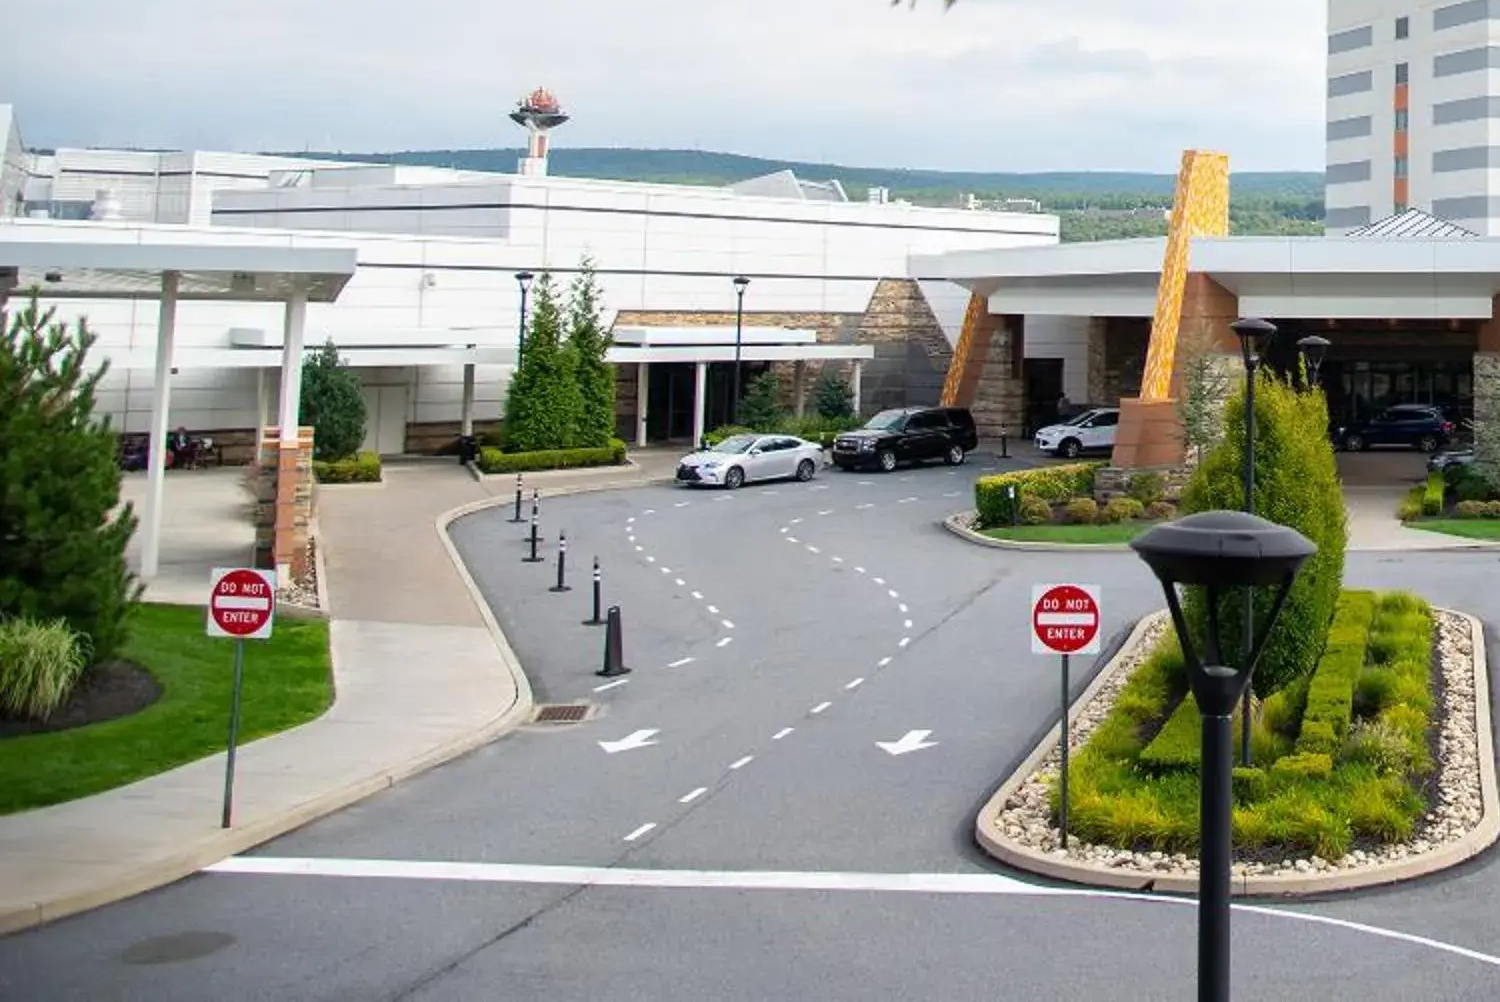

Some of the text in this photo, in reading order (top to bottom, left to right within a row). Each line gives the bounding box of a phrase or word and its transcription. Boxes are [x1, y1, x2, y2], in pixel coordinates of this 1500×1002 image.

[221, 582, 265, 594] DO NOT
[1043, 598, 1089, 610] DO NOT
[223, 611, 259, 624] ENTER
[1047, 628, 1085, 640] ENTER
